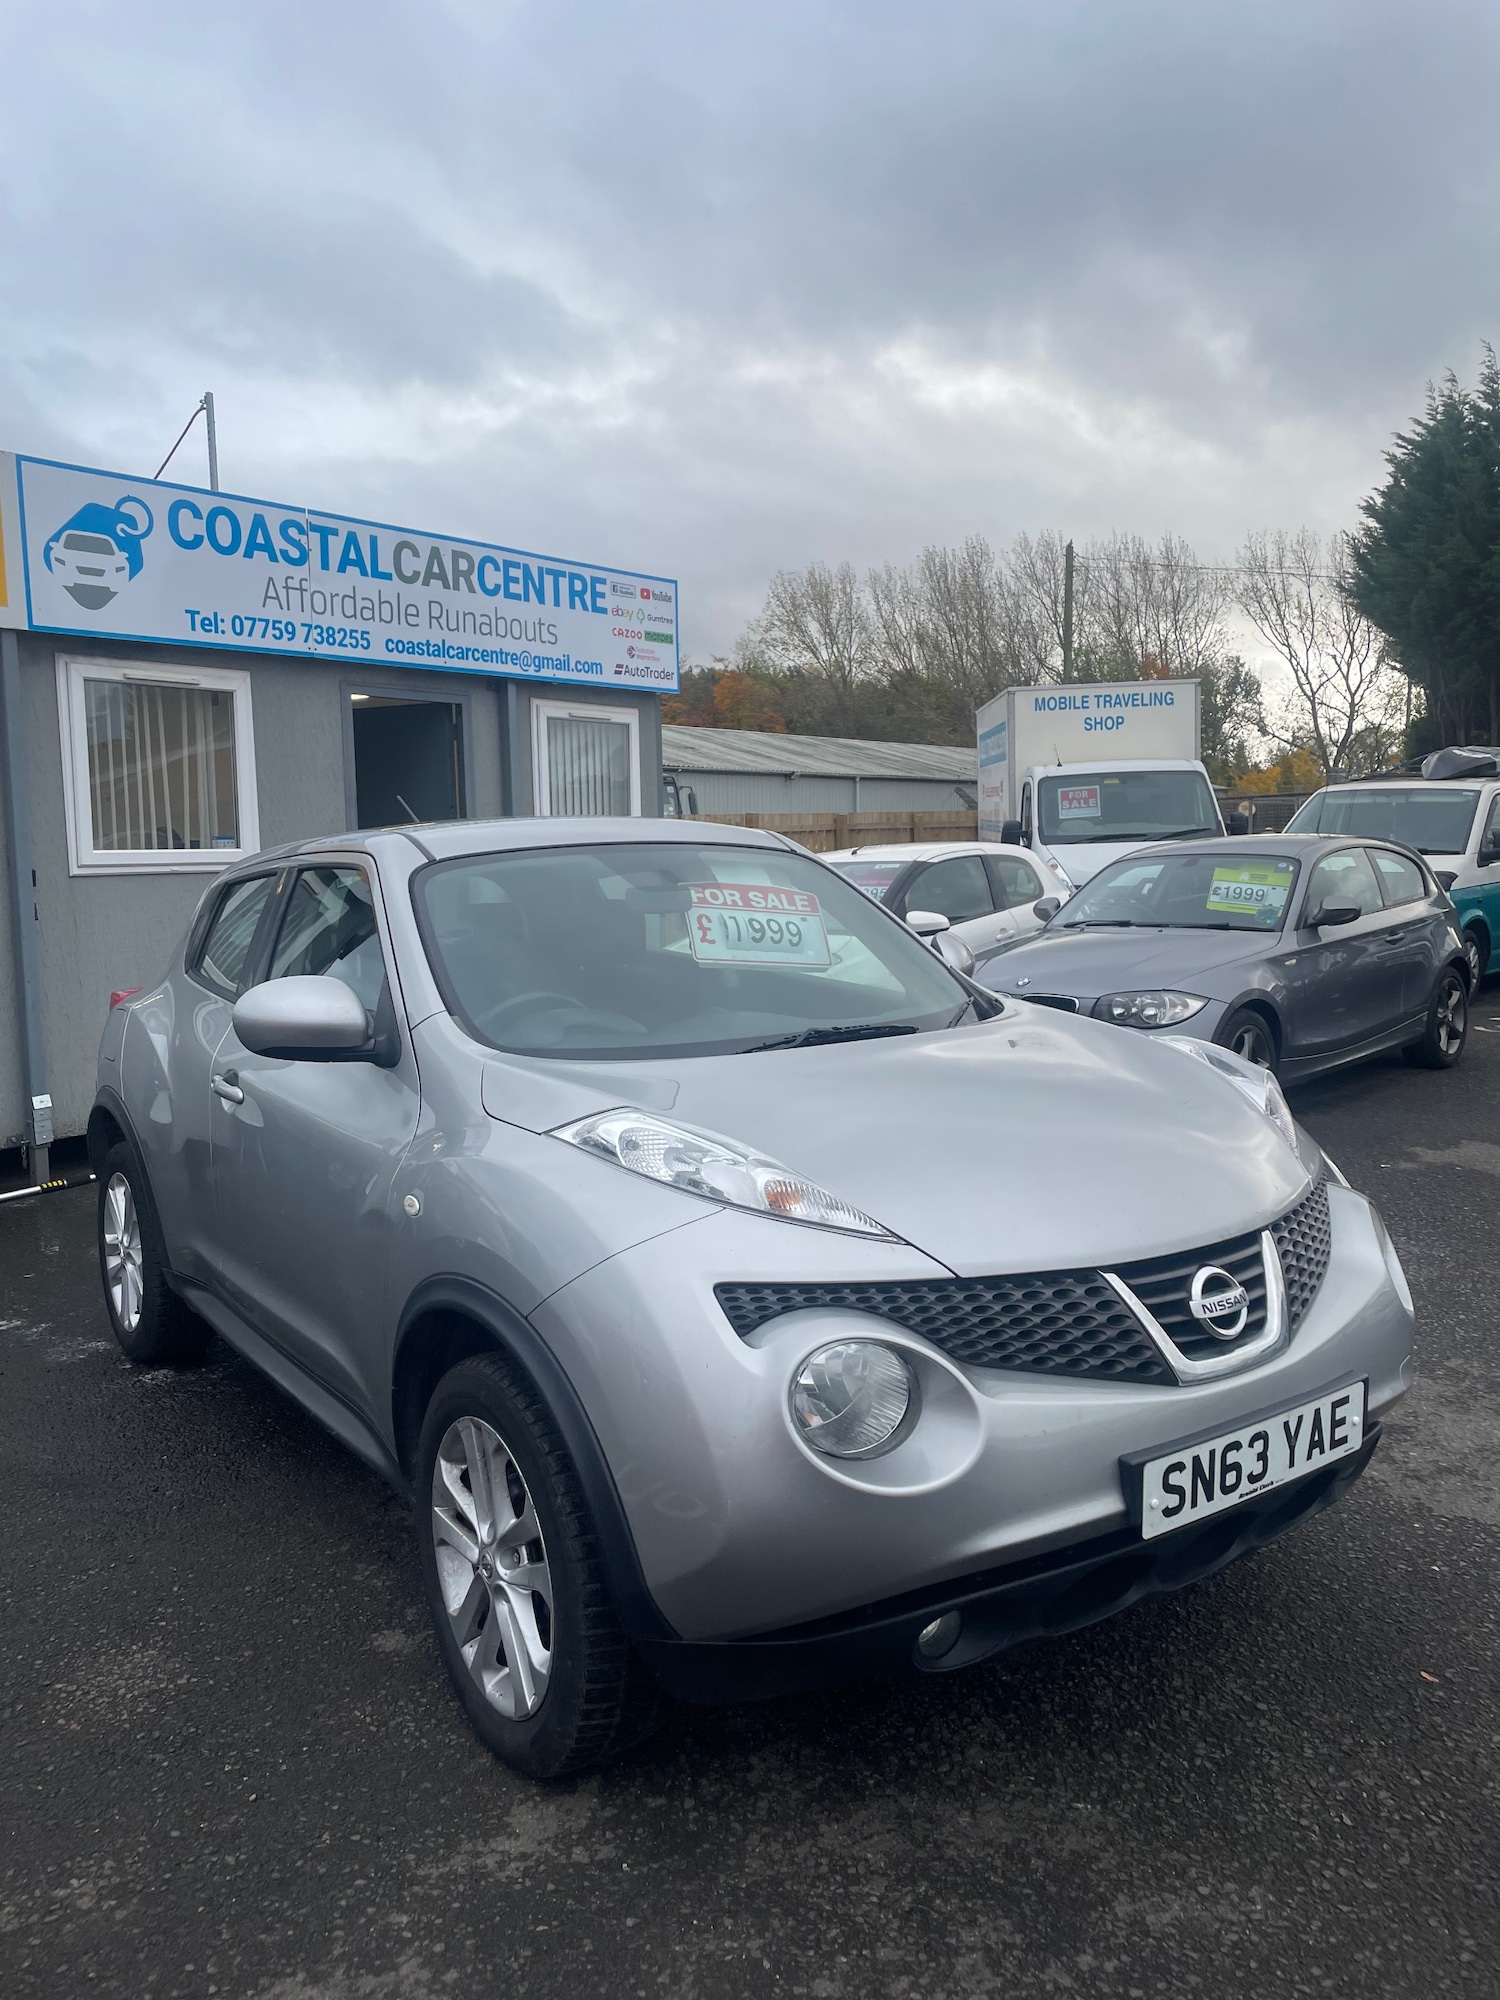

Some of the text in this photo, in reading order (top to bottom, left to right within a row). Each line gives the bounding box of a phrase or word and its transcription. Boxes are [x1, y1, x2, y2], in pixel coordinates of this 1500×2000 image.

[262, 575, 559, 646] Affordable Runabouts
[184, 609, 603, 676] Tel: 07759 738255 coastalcarcentre@gmail.com
[624, 664, 675, 680] AutoTrader
[1034, 691, 1175, 712] MOBILE TRAVELING
[1083, 715, 1125, 732] SHOP
[1062, 799, 1097, 809] SALE
[1068, 790, 1089, 799] FOR
[690, 888, 812, 912] FOR SALE
[1212, 885, 1265, 902] £1999
[1201, 1292, 1247, 1315] NISSAN
[1161, 1394, 1351, 1519] SN63 YAE
